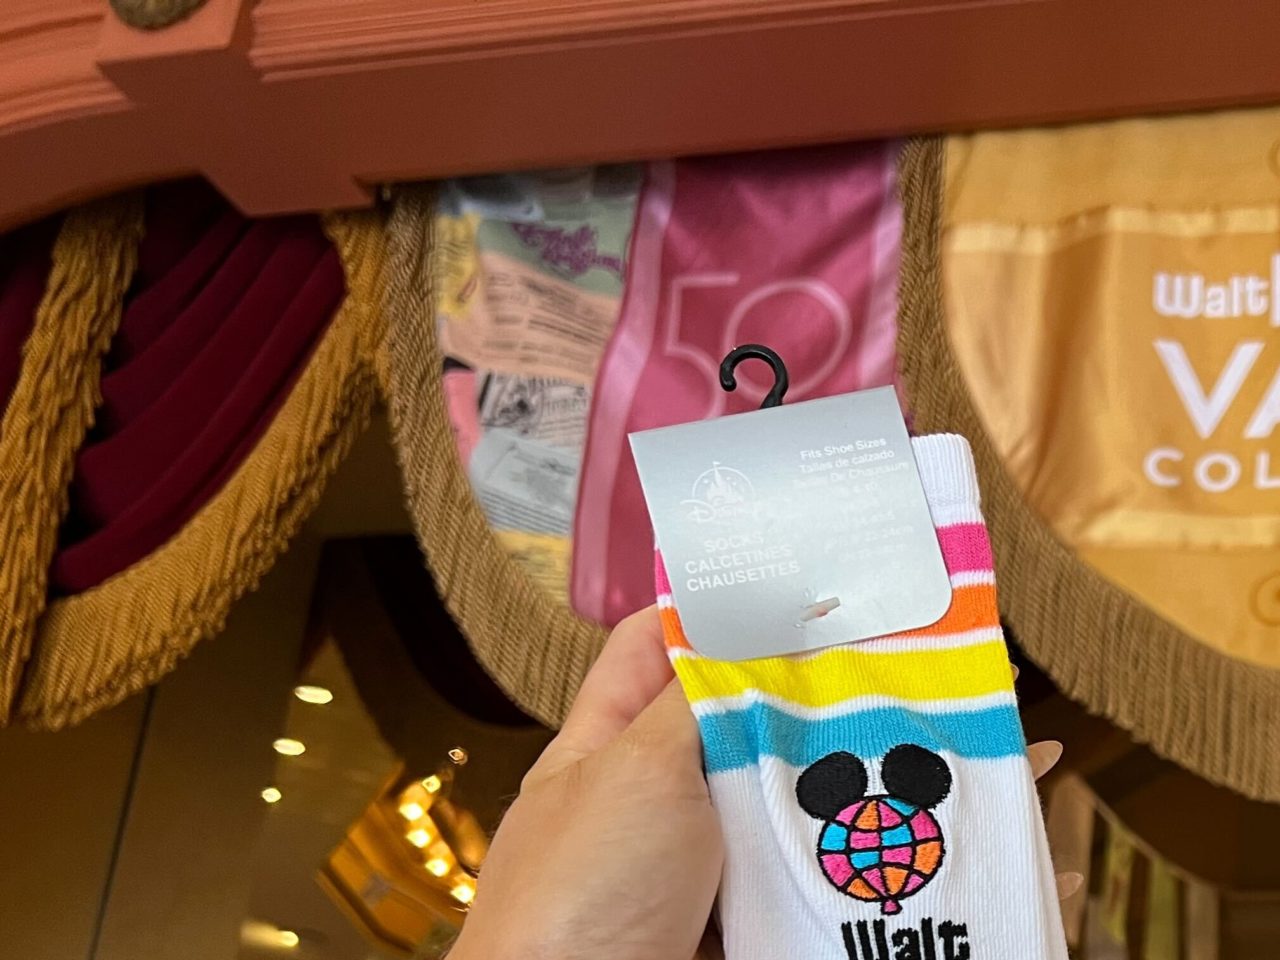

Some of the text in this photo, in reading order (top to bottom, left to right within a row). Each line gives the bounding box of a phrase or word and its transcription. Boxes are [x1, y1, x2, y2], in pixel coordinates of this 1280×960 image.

[1153, 271, 1269, 319] Walt
[799, 438, 888, 461] Fits Shoe Sizes
[851, 449, 896, 465] calzado
[684, 543, 794, 575] CALCETINES
[686, 560, 801, 592] CHAUSETTES
